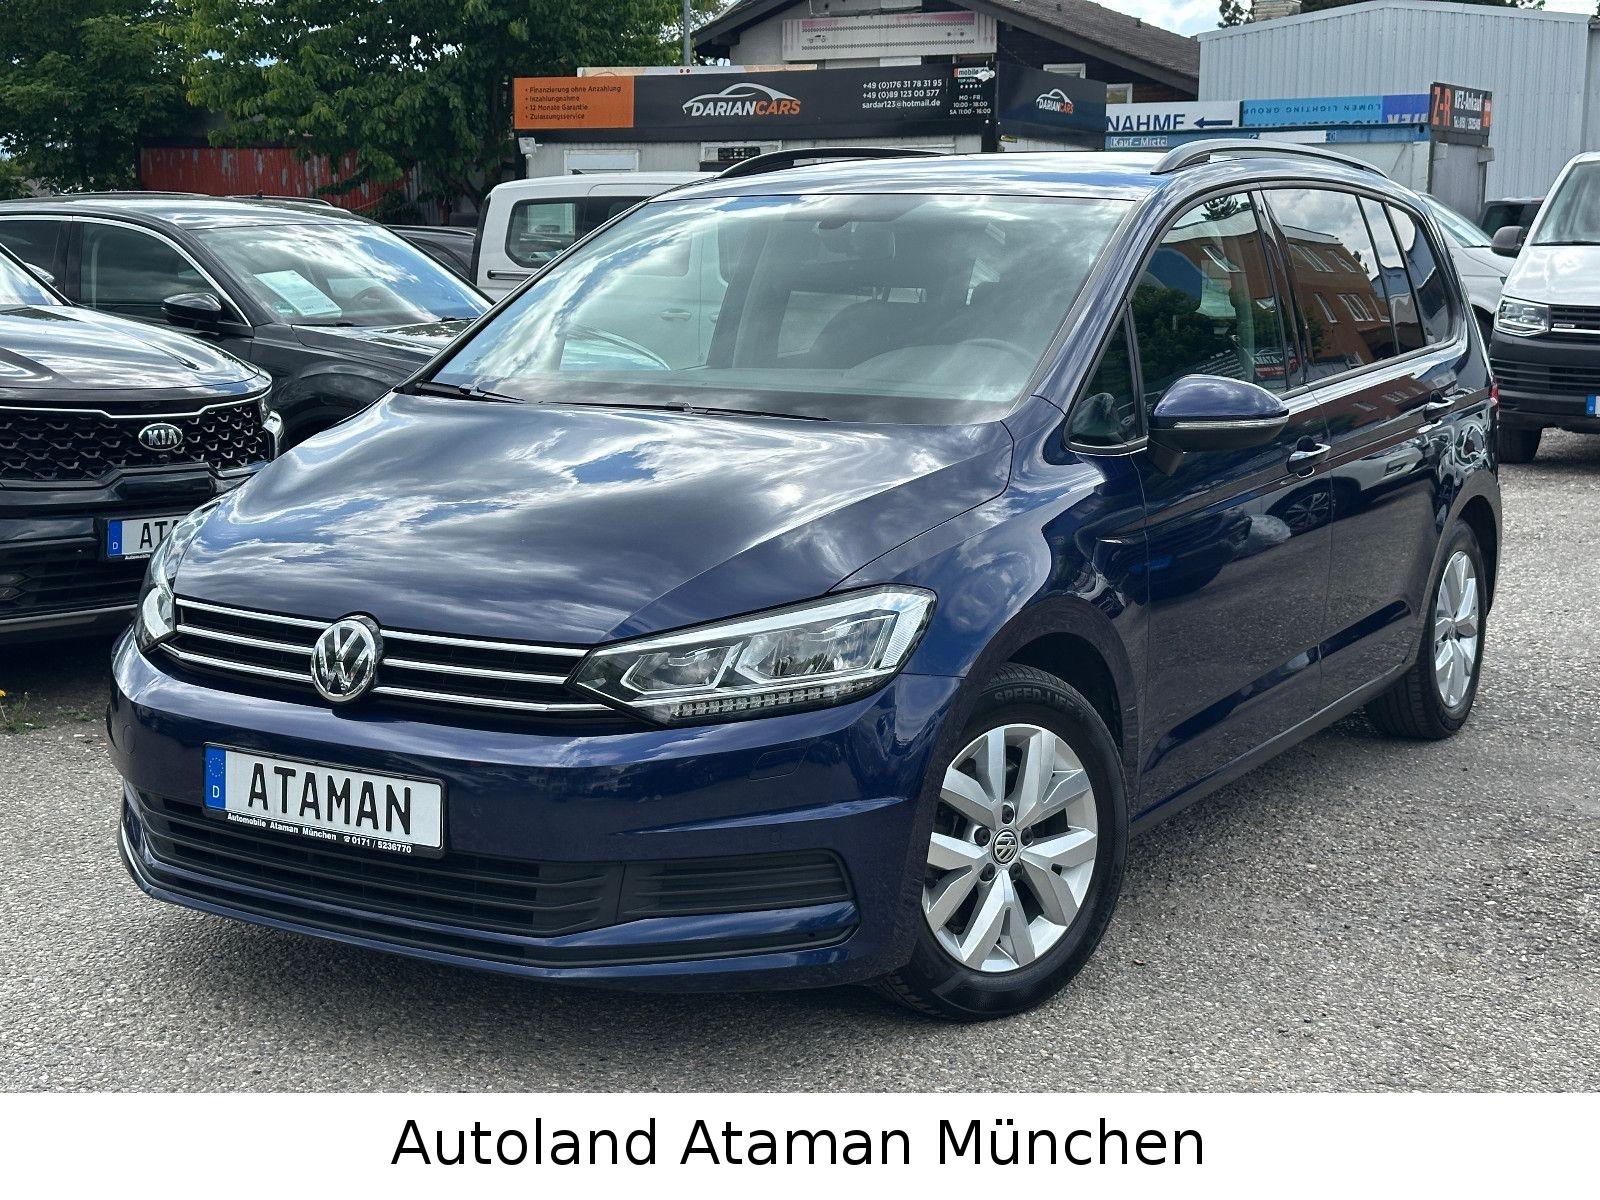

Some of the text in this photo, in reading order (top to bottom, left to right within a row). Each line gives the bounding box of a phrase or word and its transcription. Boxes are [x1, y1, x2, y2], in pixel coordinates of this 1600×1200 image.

[529, 86, 570, 94] Finanzierung
[588, 85, 621, 93] Anzahlung
[878, 81, 901, 89] (0)176
[878, 91, 898, 99] (0)89
[926, 89, 939, 97] 577
[690, 100, 801, 117] DARIANCARS
[862, 99, 940, 109] sardar123@hotmail.de
[1286, 105, 1338, 113] LIGHTING
[1344, 103, 1381, 111] LUMEN
[147, 429, 178, 446] KIA
[112, 542, 119, 550] D
[212, 762, 411, 835] D ATAMAN
[227, 812, 266, 828] Automobile
[270, 822, 298, 834] Ataman
[302, 828, 336, 841] München
[352, 837, 370, 847] 0171
[377, 841, 412, 853] 5236770
